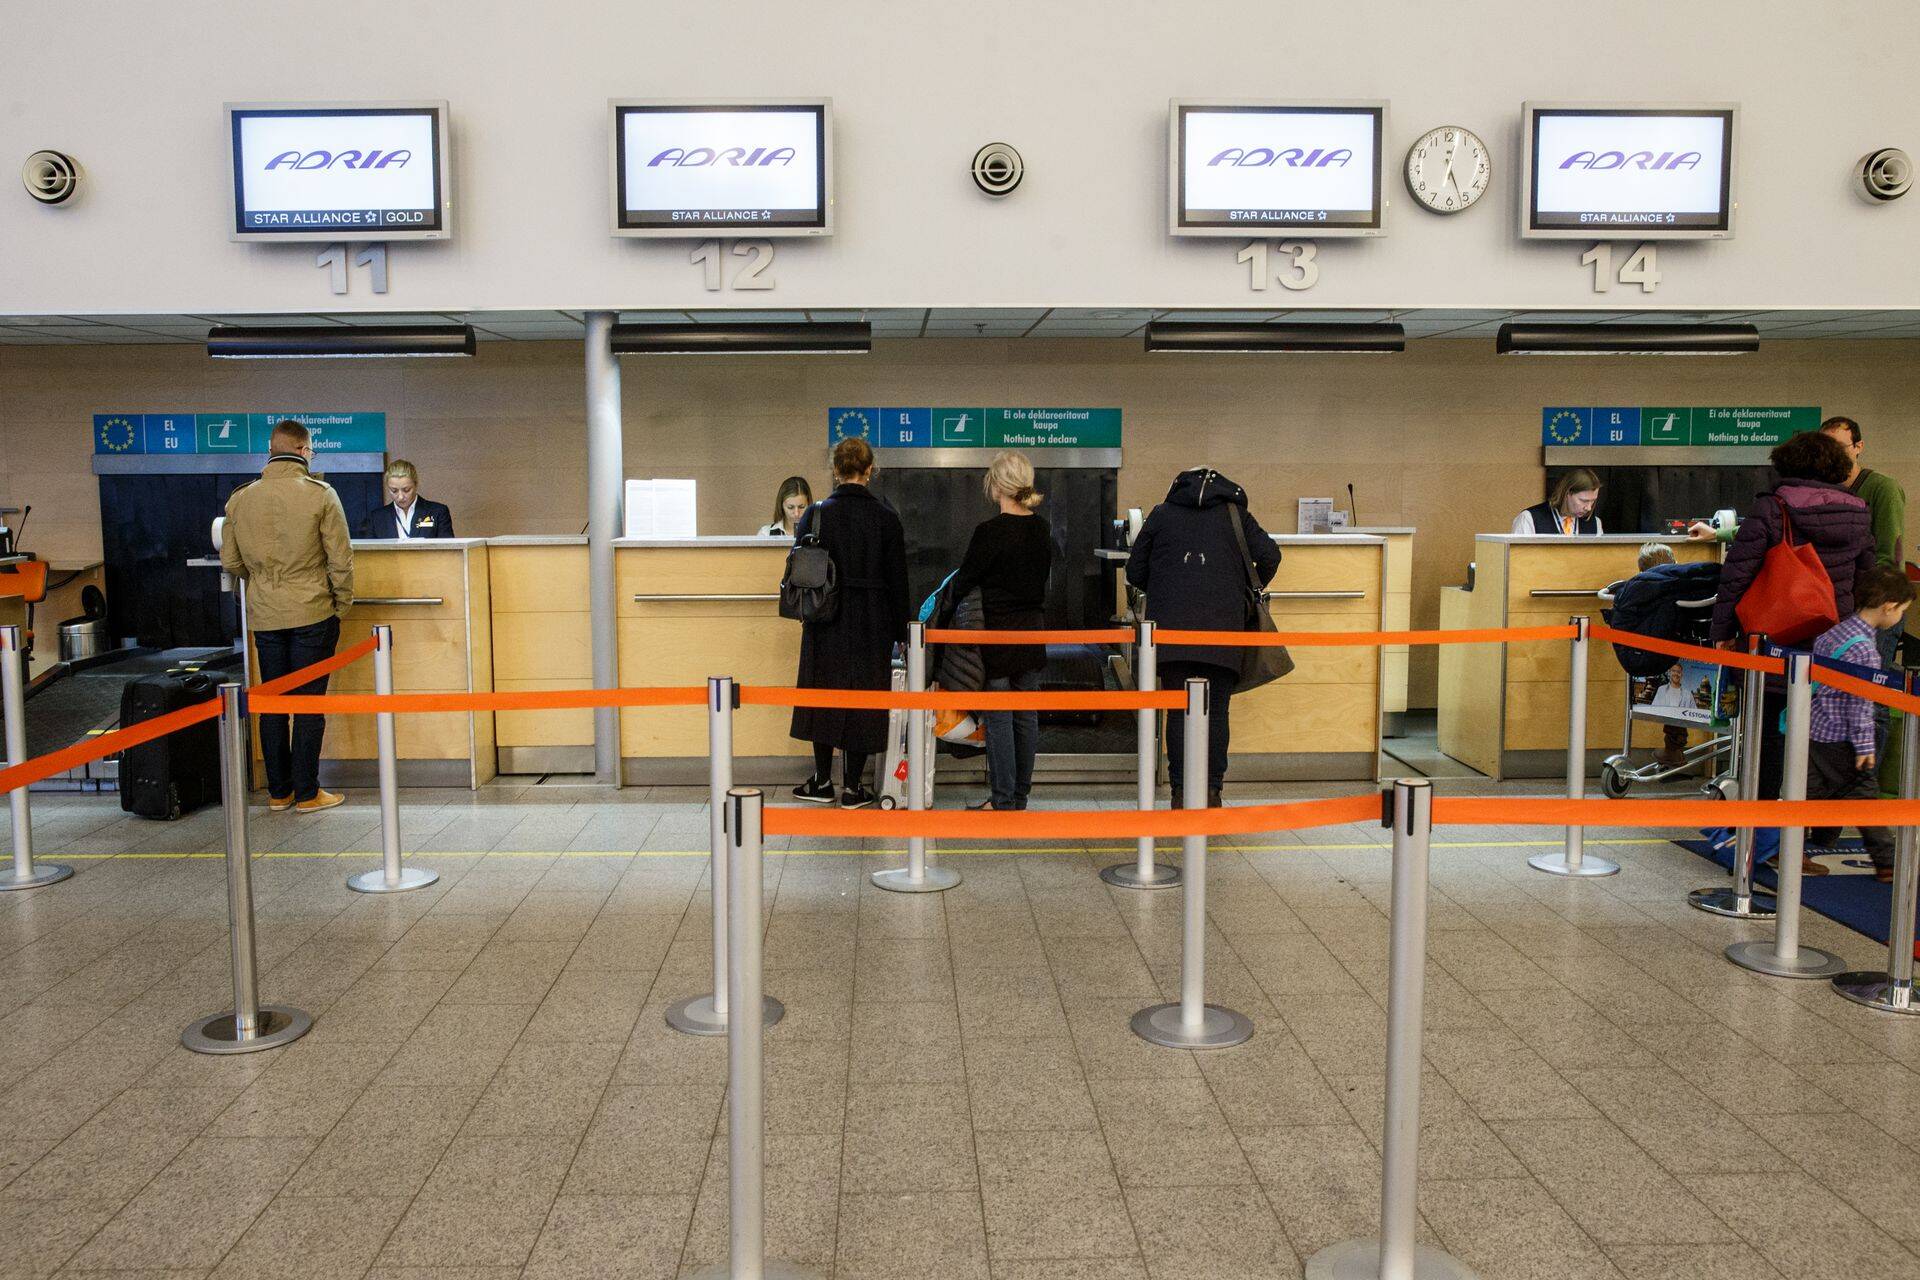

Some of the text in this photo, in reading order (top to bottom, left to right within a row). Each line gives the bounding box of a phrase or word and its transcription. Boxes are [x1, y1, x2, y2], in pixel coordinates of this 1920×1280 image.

[1444, 132, 1454, 142] 12
[264, 149, 412, 170] ADRIA
[646, 147, 796, 167] ADRIA
[1206, 148, 1353, 168] ADRIA
[1558, 151, 1702, 170] ADRIA
[1430, 192, 1438, 202] 7
[1445, 196, 1454, 206] 6
[1462, 192, 1470, 202] 5
[254, 212, 361, 224] STAR ALLIANCE
[386, 211, 424, 222] GOLD
[671, 211, 758, 220] STAR ALLIANCE
[1230, 211, 1315, 220] STAR ALLIANCE
[1580, 213, 1662, 223] STAR ALLIANCE
[316, 242, 388, 295] 11
[690, 239, 776, 291] 12
[1237, 239, 1320, 291] 13
[1581, 241, 1662, 293] 14
[900, 413, 912, 425] EL
[1003, 409, 1090, 419] Ei ole deklareeritavat
[1610, 413, 1621, 424] EL
[1709, 409, 1791, 418] Ei ole deklareeritavat
[164, 420, 175, 431] EL
[267, 415, 274, 425] Ei
[1033, 420, 1059, 431] kaupa
[1737, 419, 1761, 430] kaupa
[900, 430, 913, 442] EU
[1003, 434, 1078, 446] Nothing to declare
[1610, 430, 1623, 441] EU
[1708, 432, 1779, 444] Nothing to declare
[165, 438, 178, 448] EU
[312, 438, 342, 448] declare
[1770, 646, 1783, 659] LOT
[1871, 672, 1889, 686] LOT
